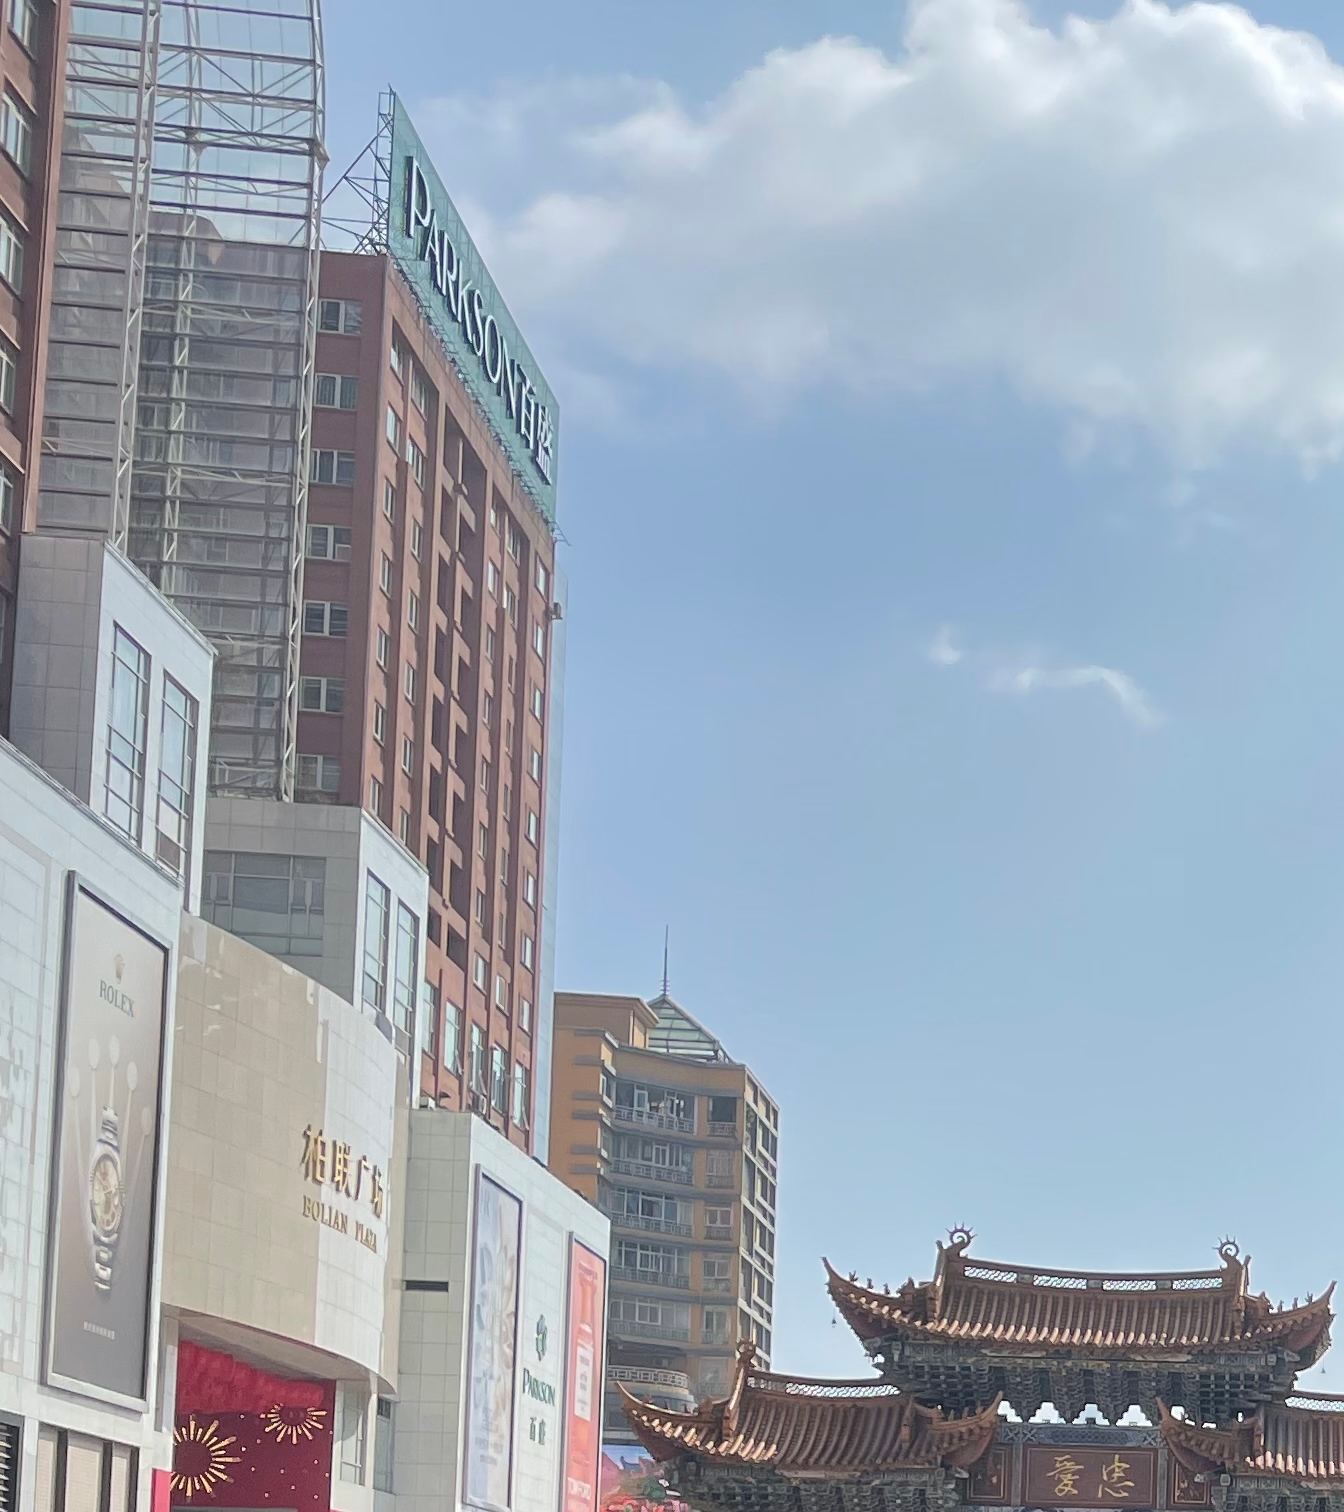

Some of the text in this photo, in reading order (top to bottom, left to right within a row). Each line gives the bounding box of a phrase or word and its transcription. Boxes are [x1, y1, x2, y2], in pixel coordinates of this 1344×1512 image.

[404, 155, 517, 419] PARKSON
[99, 979, 135, 1018] ROLEX
[300, 1124, 384, 1219] 柏联广场
[302, 1195, 377, 1254] BOLIAN PLAZA
[522, 1367, 556, 1407] PARKSON
